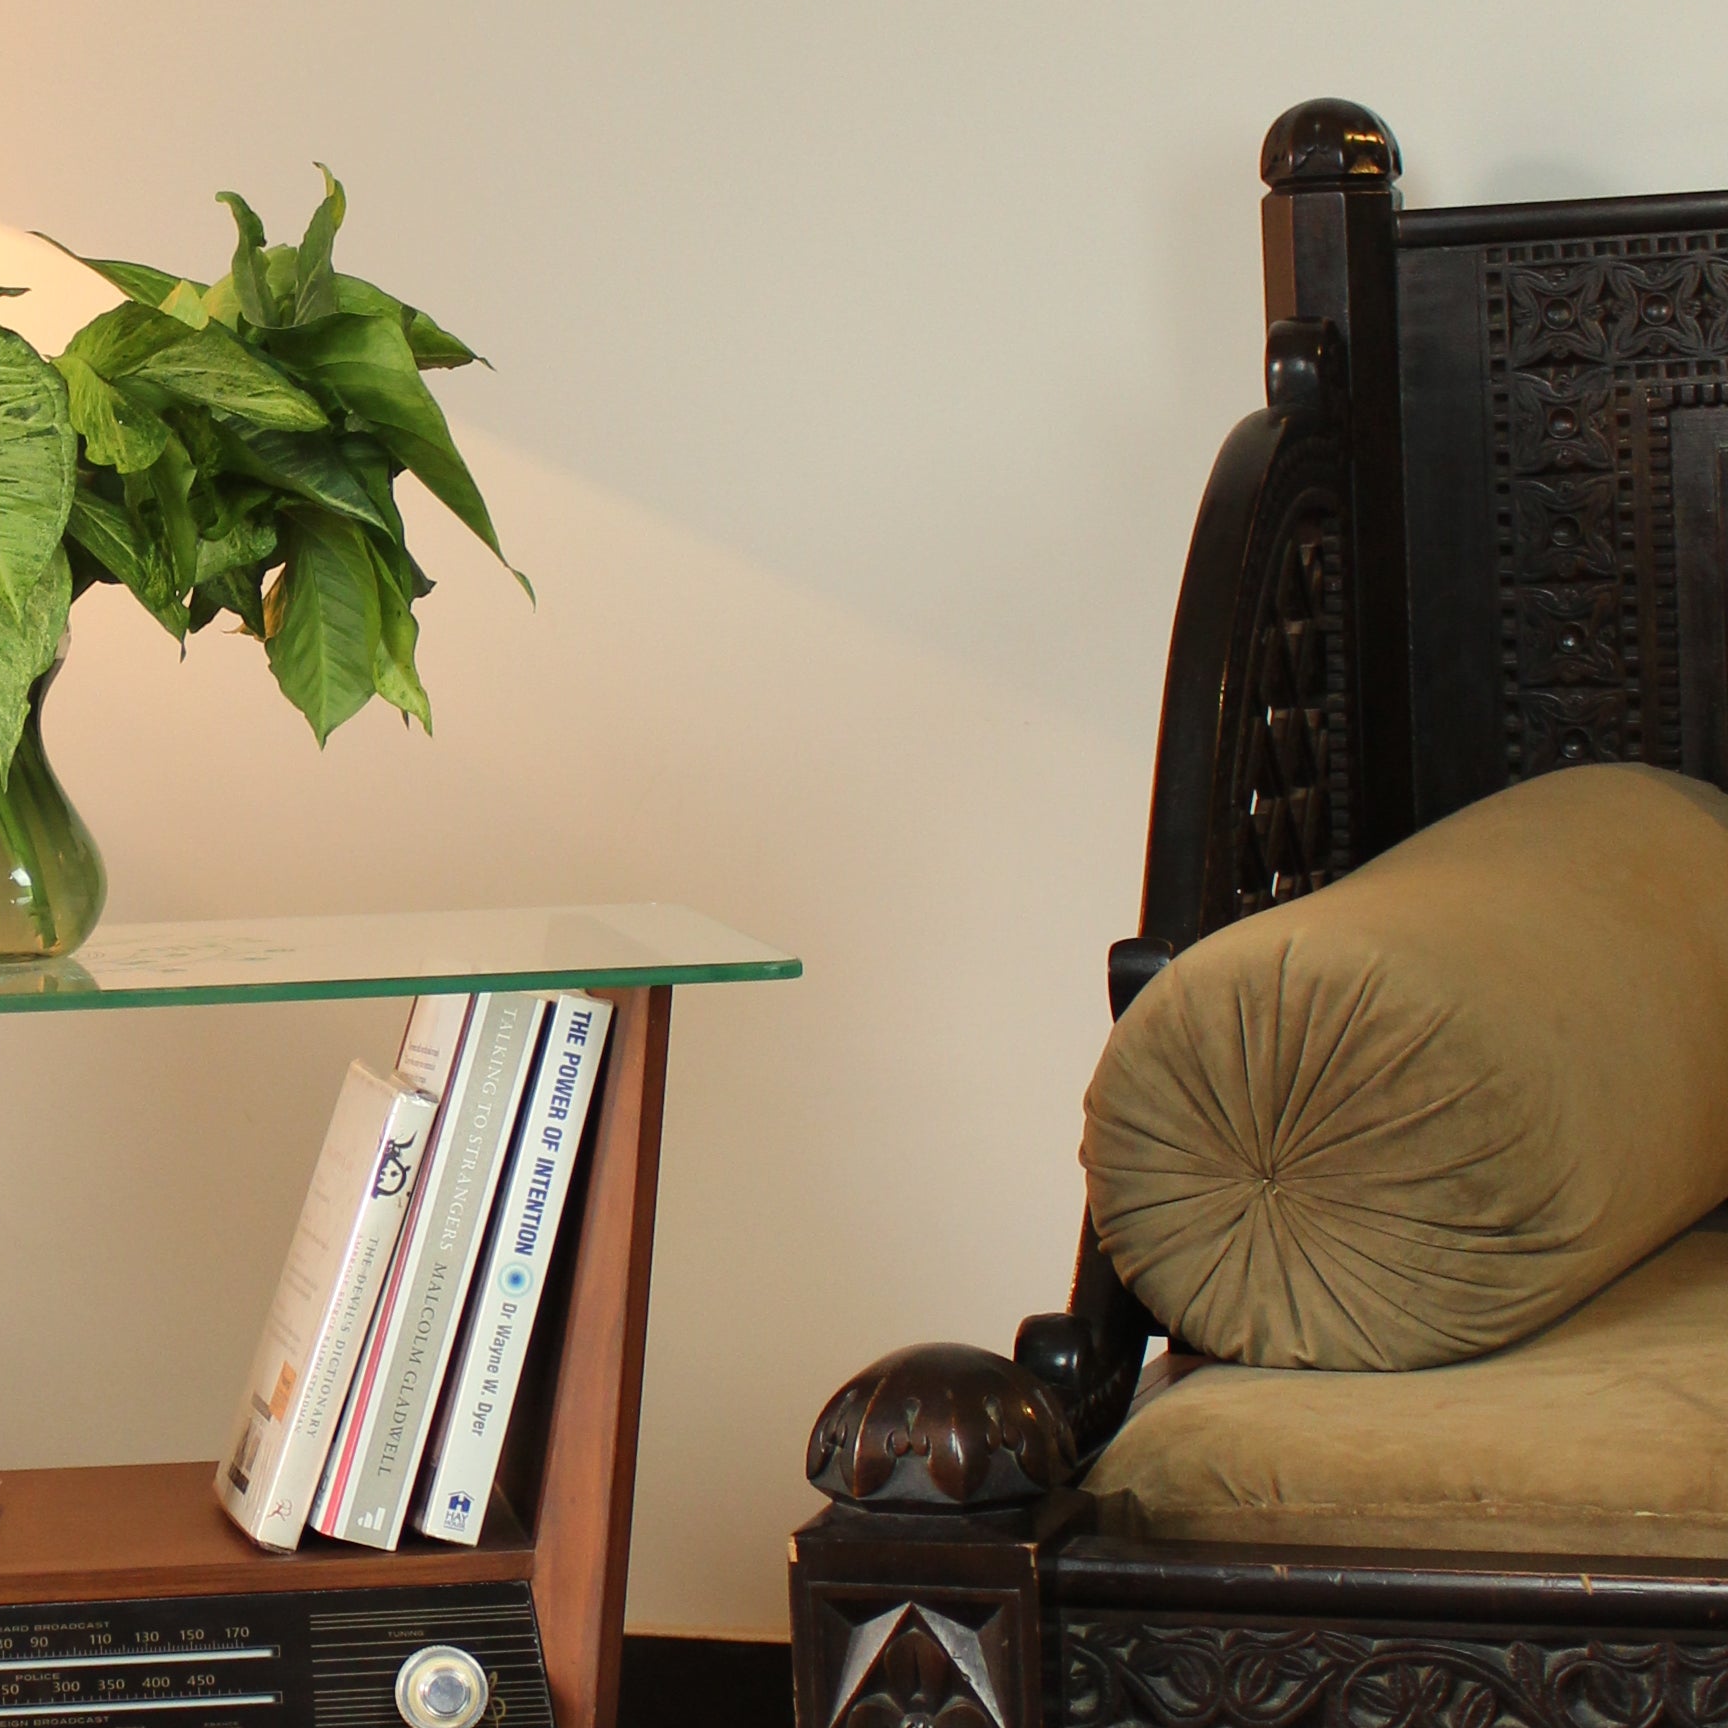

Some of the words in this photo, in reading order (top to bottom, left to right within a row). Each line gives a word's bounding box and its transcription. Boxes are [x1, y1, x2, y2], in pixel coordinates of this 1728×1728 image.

[566, 1010, 592, 1047] THE
[482, 1008, 518, 1095] TALKING
[548, 1051, 582, 1121] POWER
[474, 1102, 493, 1129] TO
[541, 1127, 563, 1153] OF
[440, 1134, 483, 1252] STRANGERS
[514, 1157, 555, 1256] INTENTION
[361, 1237, 380, 1268] THE
[340, 1273, 367, 1333] DEVIL'S
[409, 1261, 448, 1364] MALCOLM
[501, 1302, 518, 1320] Dr
[487, 1325, 512, 1374] Wayne
[306, 1339, 346, 1439] DICTIONARY
[481, 1379, 499, 1396] W.
[377, 1370, 418, 1476] GLADWELL
[472, 1402, 493, 1437] Dyer
[445, 1510, 469, 1523] HAY
[30, 1636, 49, 1648] 90
[90, 1633, 112, 1645] 110
[135, 1631, 160, 1643] 130
[180, 1629, 204, 1641] 150
[225, 1626, 249, 1638] 170
[34, 1621, 111, 1631] BROADCAST
[15, 1673, 61, 1682] POLICE
[53, 1681, 80, 1693] 300
[98, 1679, 125, 1691] 350
[142, 1676, 170, 1688] 400
[187, 1674, 215, 1686] 450
[33, 1716, 109, 1726] BROADCAST
